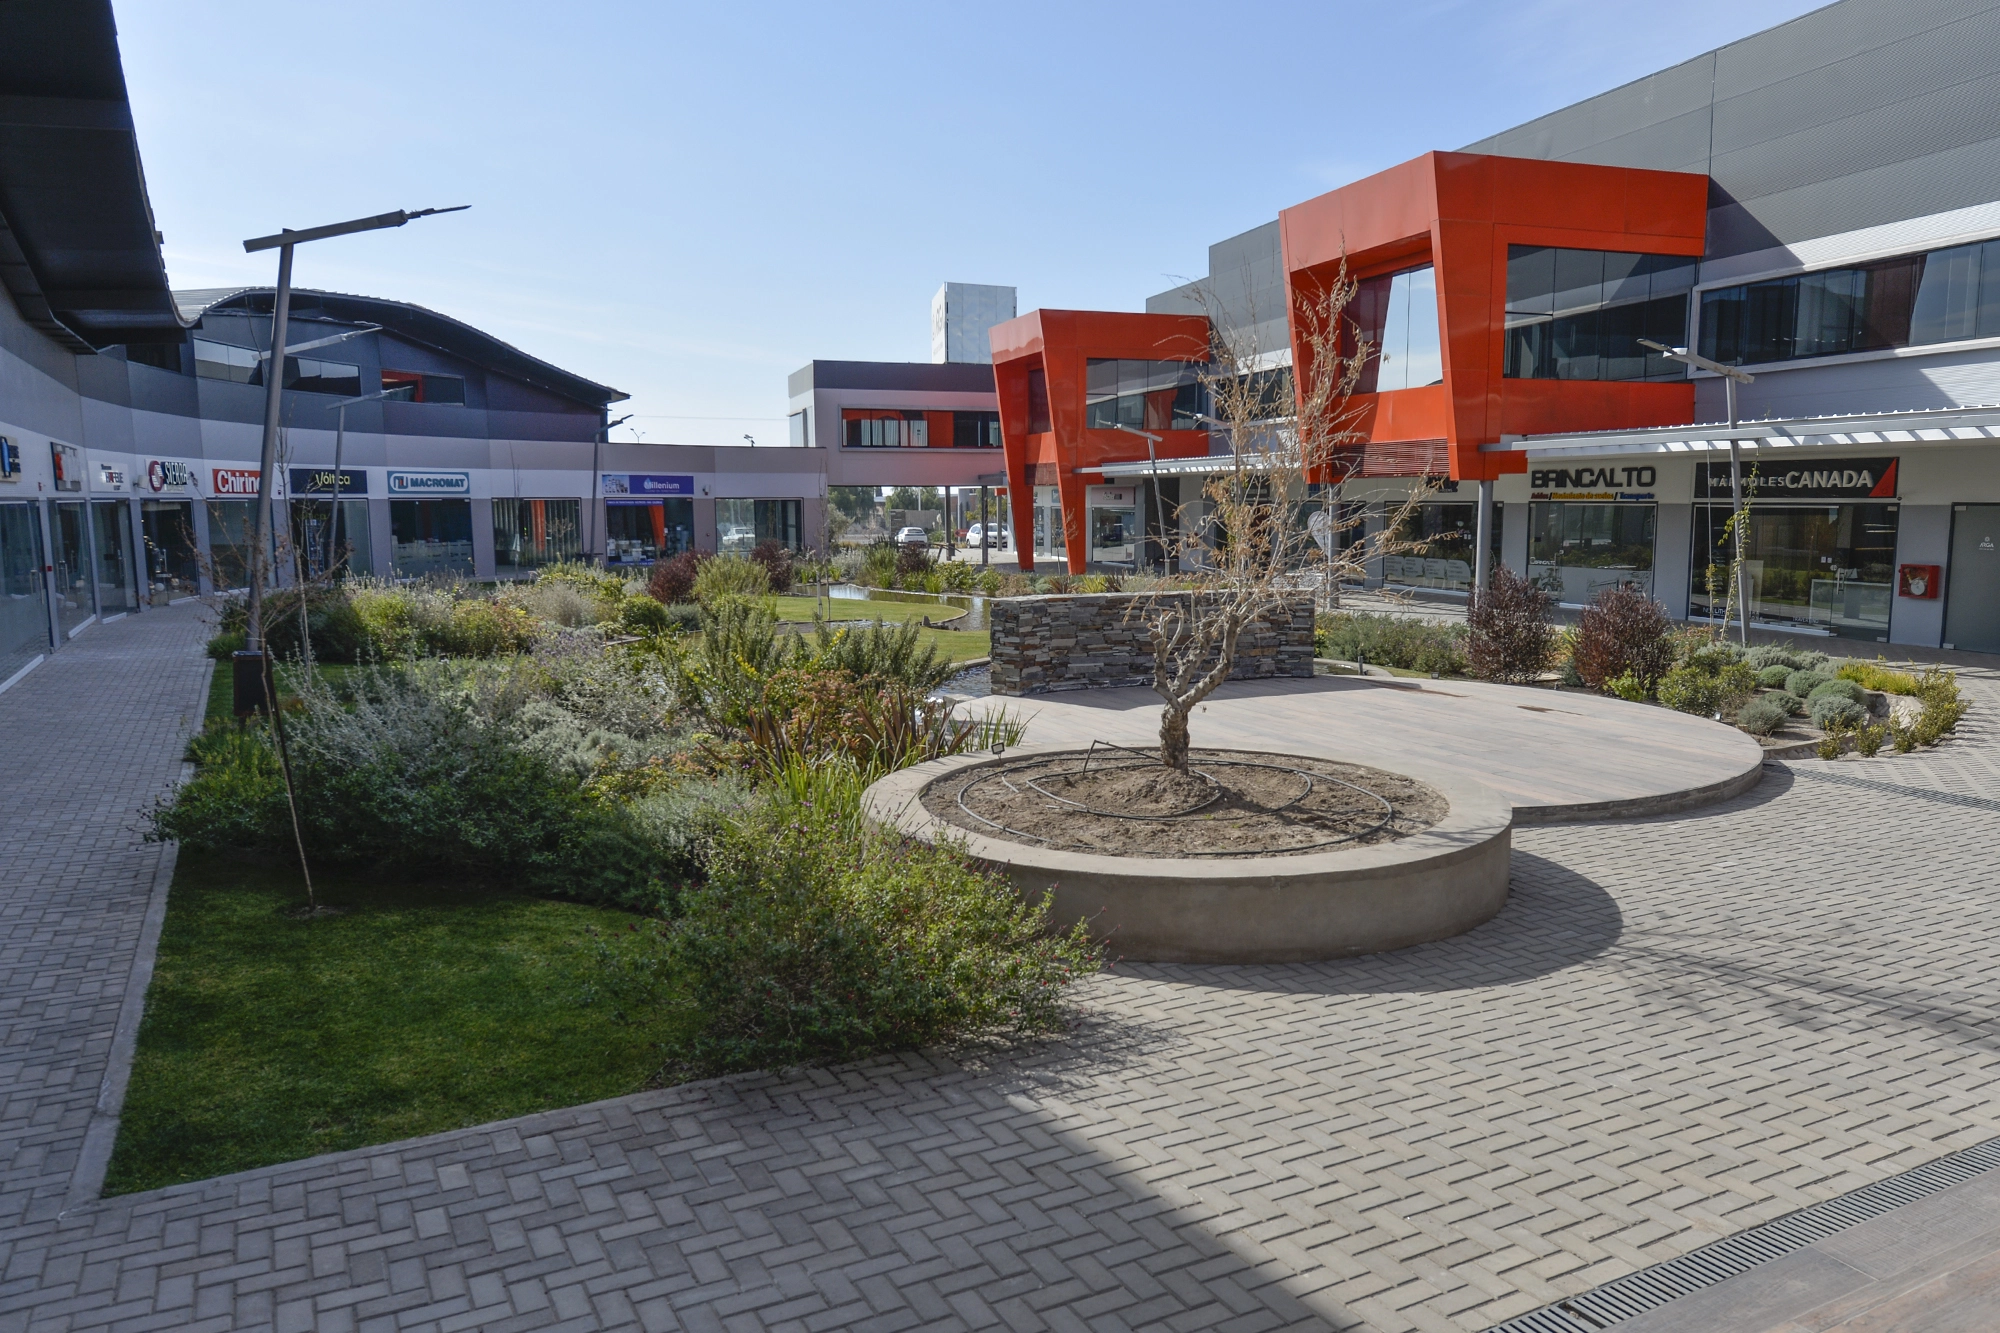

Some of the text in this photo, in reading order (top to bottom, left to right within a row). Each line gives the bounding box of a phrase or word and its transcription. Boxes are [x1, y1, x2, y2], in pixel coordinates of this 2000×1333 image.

[315, 471, 351, 486] Vóltca
[410, 479, 465, 488] MACROMAT
[644, 481, 679, 489] Millenium
[1531, 466, 1656, 489] BRINCALTO
[1785, 469, 1874, 488] CANADA
